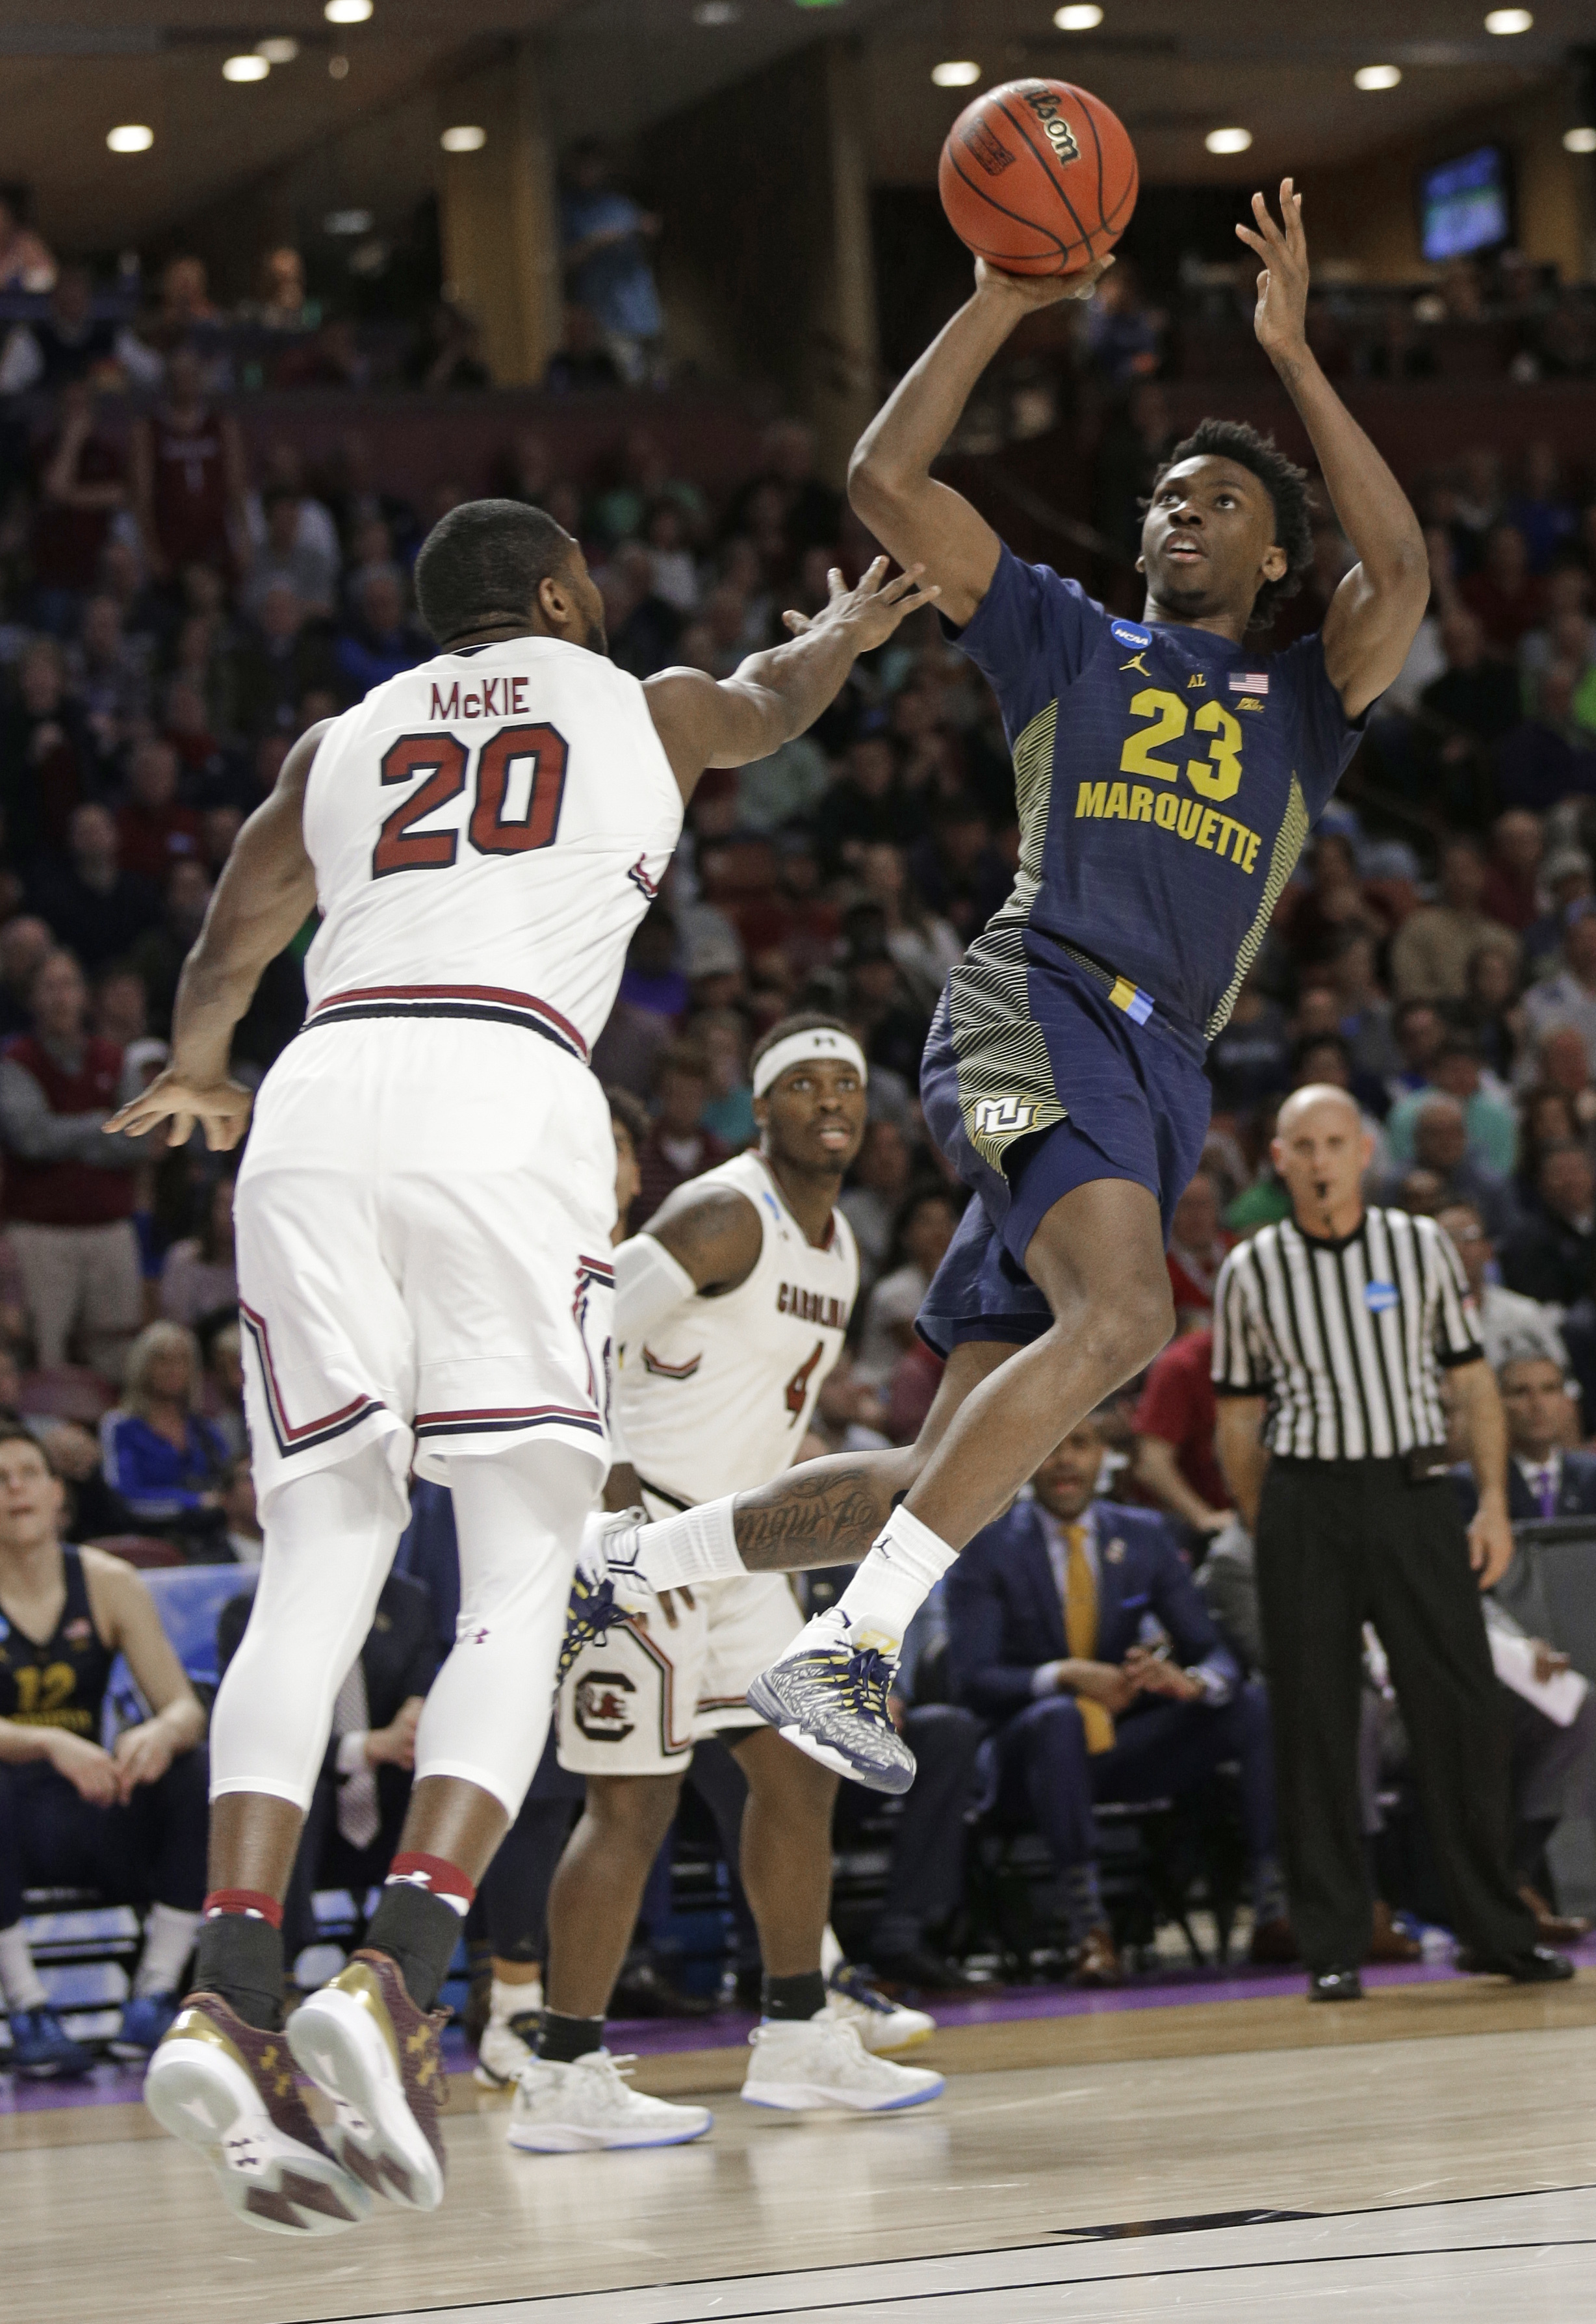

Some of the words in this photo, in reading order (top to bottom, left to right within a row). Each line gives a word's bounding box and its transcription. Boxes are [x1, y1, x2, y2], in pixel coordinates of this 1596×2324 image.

[1018, 86, 1079, 166] ilson
[1114, 628, 1149, 646] NCAA
[430, 676, 531, 721] McKIE
[1187, 673, 1207, 689] AL
[1119, 688, 1243, 803] 23
[372, 721, 569, 881] 20
[1074, 781, 1262, 875] MARQUETTE
[785, 1339, 825, 1429] 4
